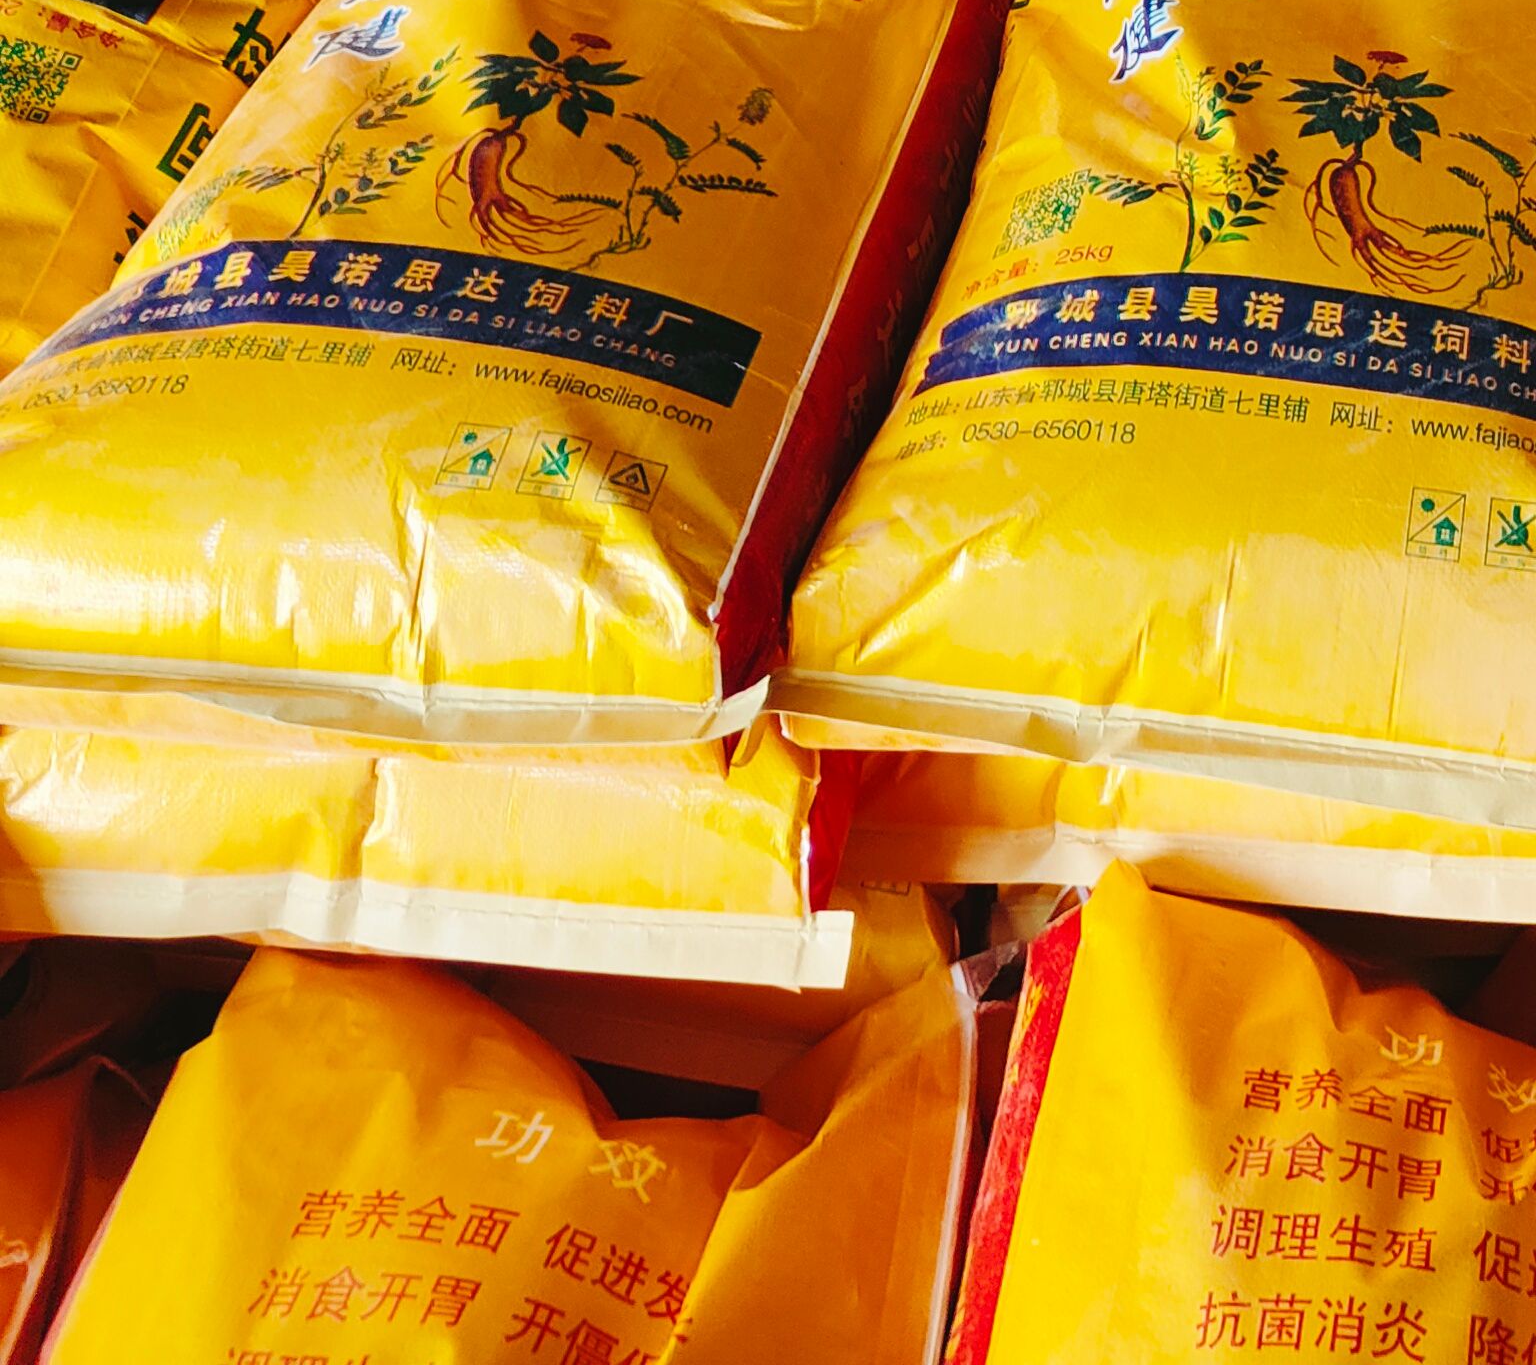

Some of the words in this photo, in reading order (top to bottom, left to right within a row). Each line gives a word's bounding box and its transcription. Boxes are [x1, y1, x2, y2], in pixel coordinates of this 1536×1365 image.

[1054, 241, 1113, 268] 25kg
[138, 295, 213, 324] CHENG
[221, 289, 281, 313] XIAN
[286, 291, 341, 311] HAO
[351, 295, 406, 317] NUO
[415, 304, 439, 321] SI
[448, 308, 481, 327] DA
[492, 314, 516, 331] SI
[524, 320, 583, 344] LIAO
[591, 333, 679, 369] CHANG
[992, 335, 1041, 358] YUN
[1049, 329, 1129, 352] CHENG
[1138, 331, 1199, 351] XIAN
[1208, 337, 1260, 357] HAO
[1270, 342, 1323, 364] NUO
[1333, 351, 1358, 368] SI
[1368, 355, 1401, 374] DA
[1409, 361, 1434, 380] SI
[1443, 367, 1499, 392] LIAO
[390, 347, 460, 378] 网址：
[474, 358, 714, 435] www.fajiaosiliao.com
[1329, 399, 1396, 437] 网址：
[961, 418, 1138, 447] 0530-6560118
[1242, 1067, 1455, 1137] 营养全面
[1227, 1131, 1445, 1203] 消食开胃
[291, 1189, 520, 1255] 营养全面
[544, 1222, 693, 1326] 促进发
[1211, 1204, 1438, 1274] 调理生殖
[248, 1265, 482, 1328] 消食开胃
[1195, 1290, 1428, 1365] 抗菌消炎
